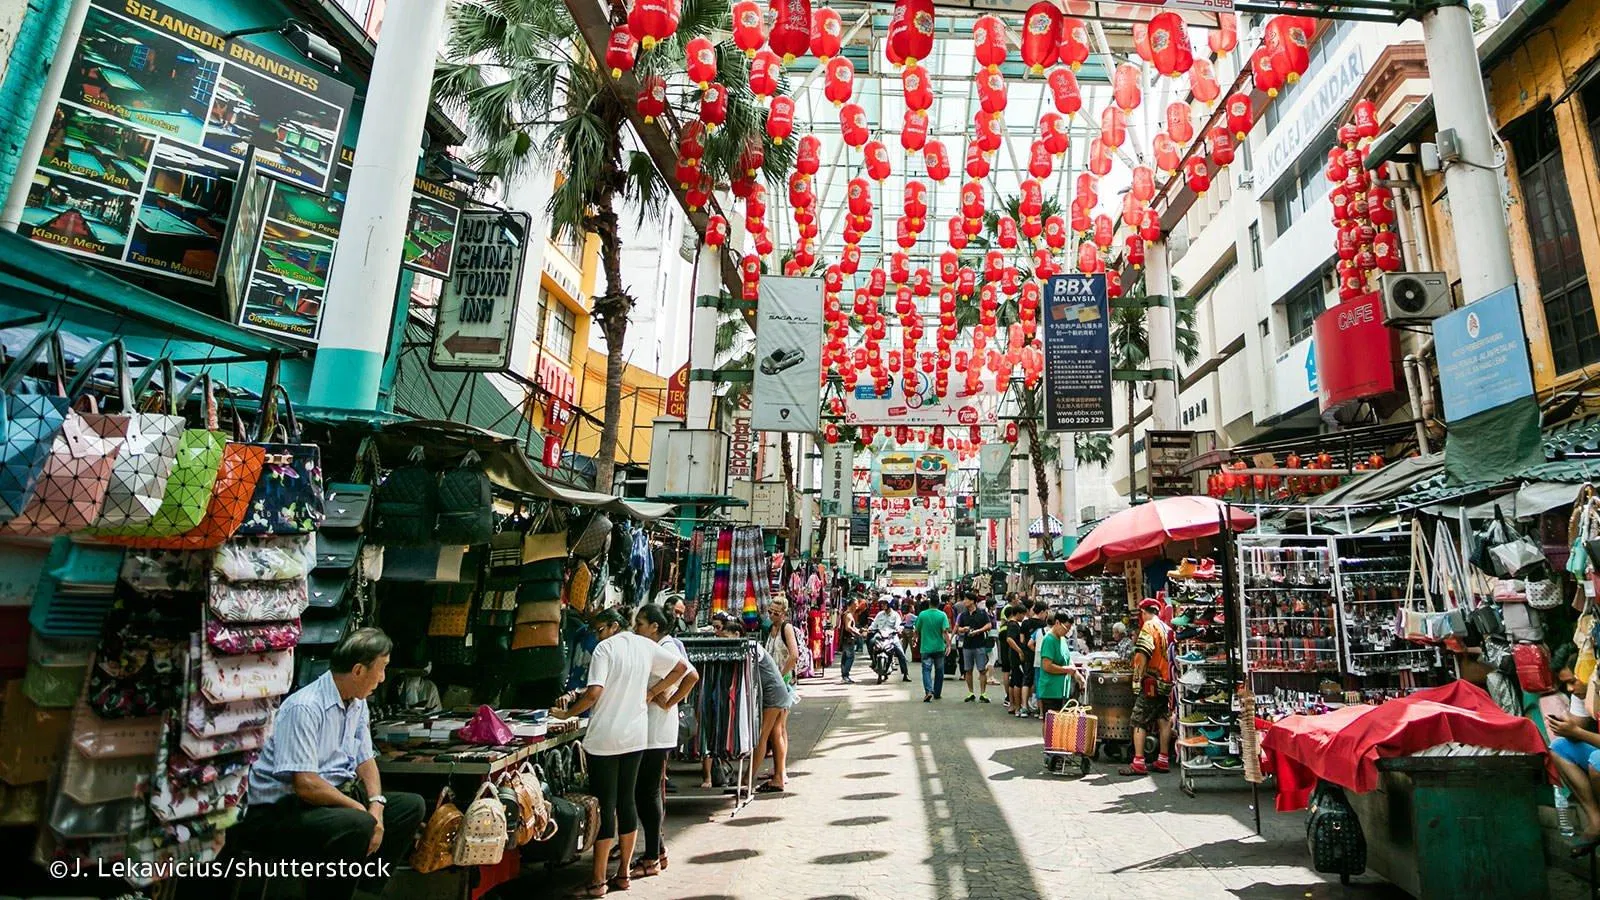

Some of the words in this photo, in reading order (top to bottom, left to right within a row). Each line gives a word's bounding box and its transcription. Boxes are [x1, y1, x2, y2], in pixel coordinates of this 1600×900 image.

[125, 0, 226, 51] SELANGOR
[229, 43, 319, 92] BRANCHES
[82, 94, 131, 119] Sunway
[1267, 119, 1301, 174] KOLEJ
[1303, 52, 1360, 135] BANDAR
[50, 156, 98, 178] Amcorp
[102, 171, 129, 187] Mall
[287, 212, 317, 230] Subang
[31, 227, 70, 246] Klang
[73, 237, 106, 253] Meru
[131, 251, 167, 268] Taman
[170, 261, 212, 279] Mayang
[455, 245, 514, 271] CHINA
[266, 264, 290, 276] Salak
[293, 271, 316, 283] South
[454, 271, 511, 297] TOWN
[1054, 278, 1095, 295] BBX
[459, 298, 496, 323] INN
[1338, 303, 1374, 331] CAFE
[290, 325, 312, 335] Road
[537, 353, 577, 406] HOTEL
[670, 390, 685, 402] TEK
[733, 417, 751, 468] CHEONG
